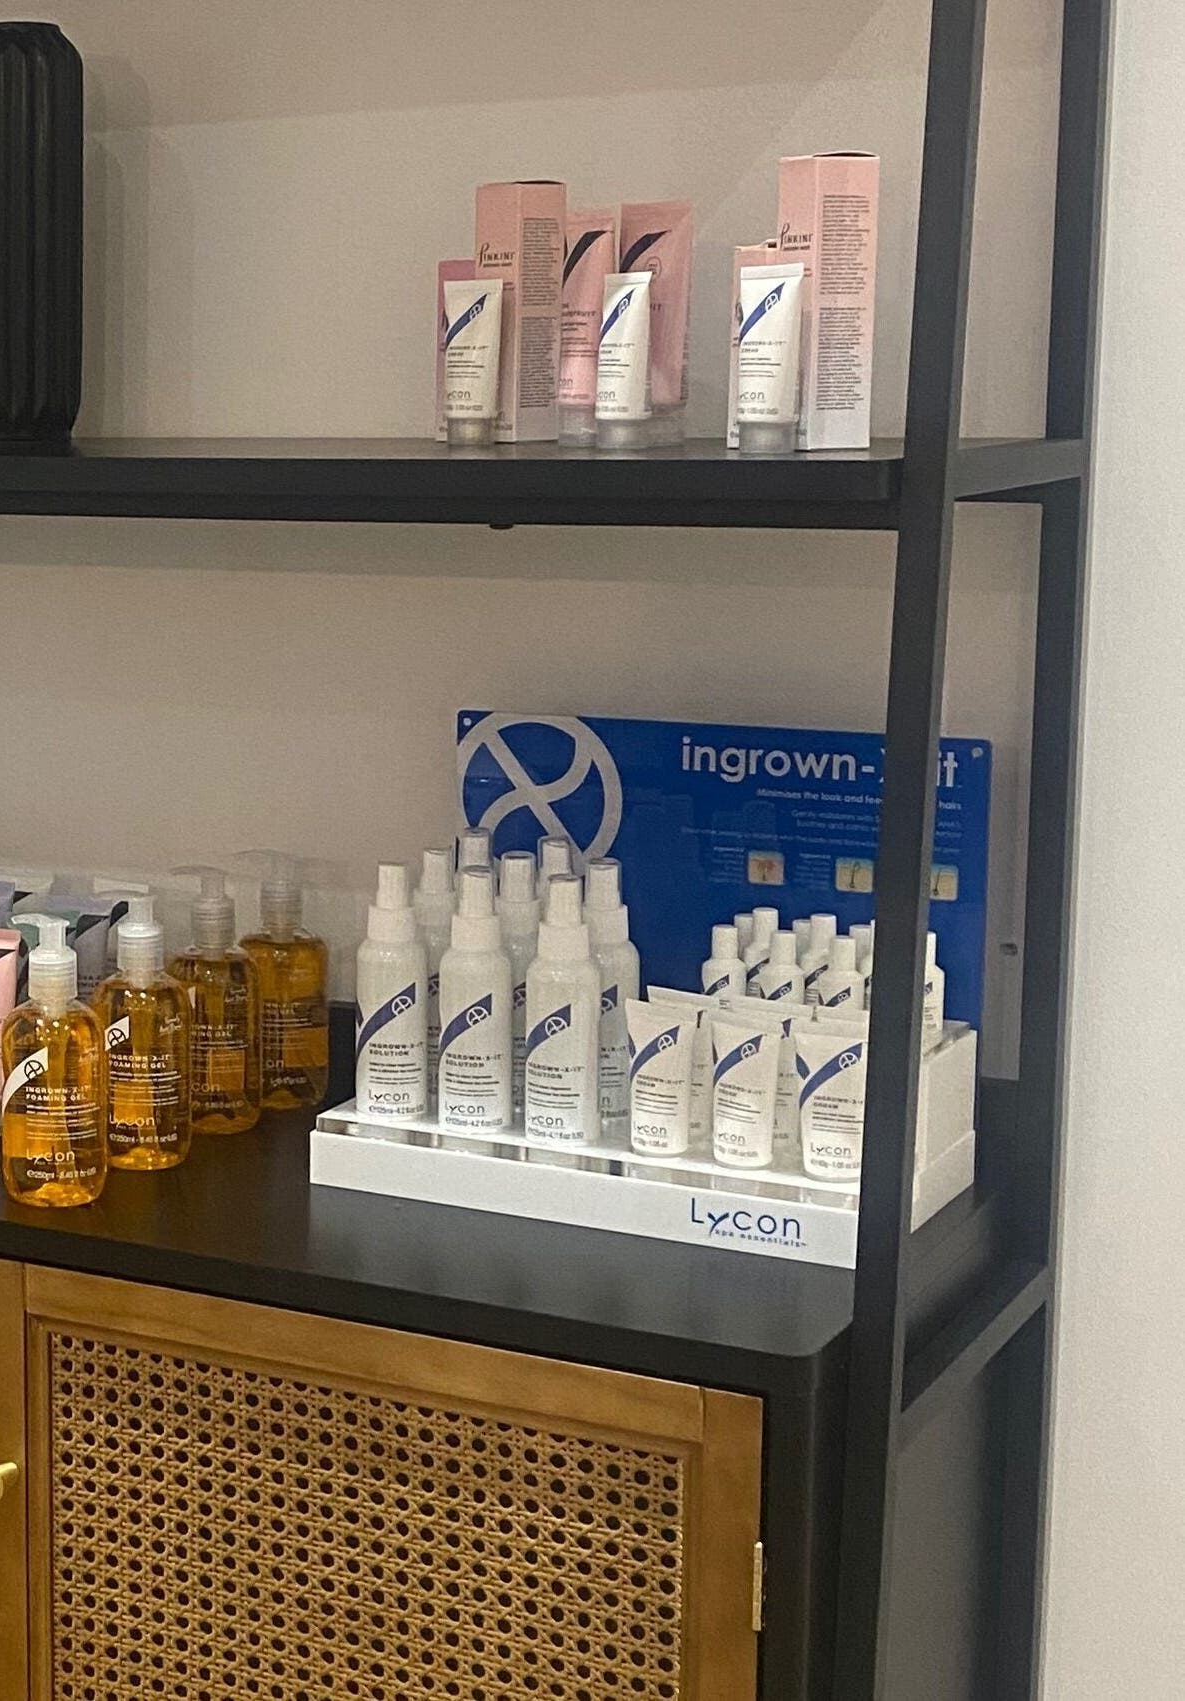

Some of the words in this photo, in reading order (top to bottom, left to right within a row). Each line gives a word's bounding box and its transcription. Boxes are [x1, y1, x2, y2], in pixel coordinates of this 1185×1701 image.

[369, 1049, 410, 1057] SOLUTION
[150, 1061, 167, 1069] GEL
[445, 1059, 485, 1068] SOLUTION
[25, 1093, 67, 1102] FOAMING
[70, 1094, 87, 1102] GEL
[368, 1089, 411, 1103] Lycon
[810, 1142, 852, 1156] Lycon
[691, 1197, 801, 1240] Lycon
